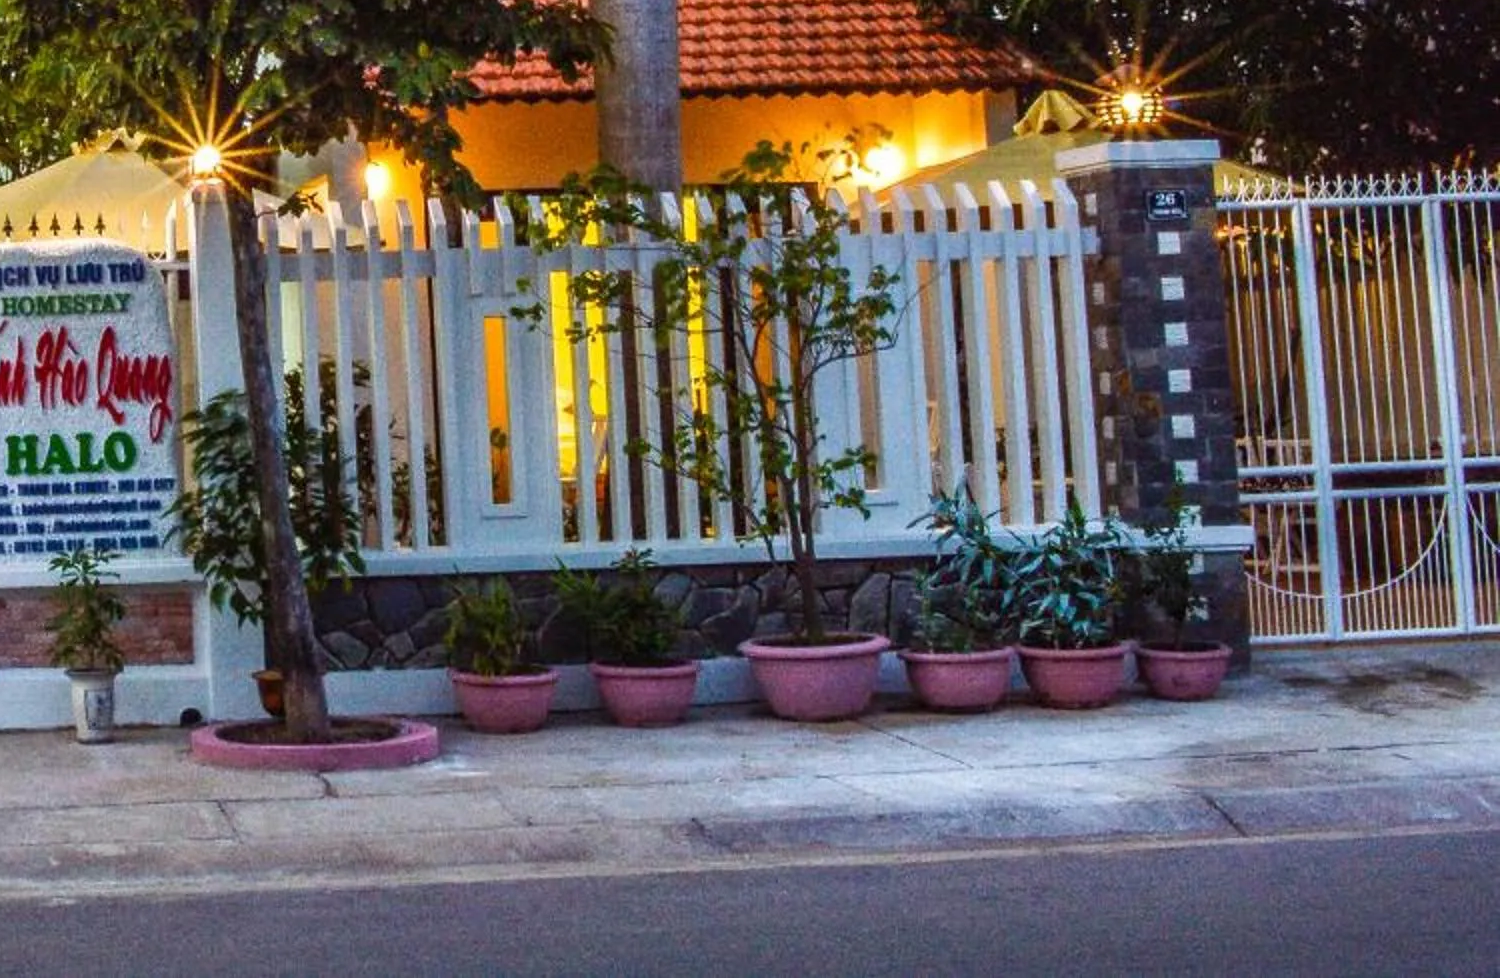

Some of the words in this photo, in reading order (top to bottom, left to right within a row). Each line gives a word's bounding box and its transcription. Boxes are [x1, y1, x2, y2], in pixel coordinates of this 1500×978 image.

[1155, 193, 1175, 207] 26
[35, 264, 61, 289] VỤ
[1, 293, 132, 317] HOMESTAY
[34, 325, 88, 412] Hào
[96, 325, 172, 444] Quang
[6, 431, 137, 475] HALO
